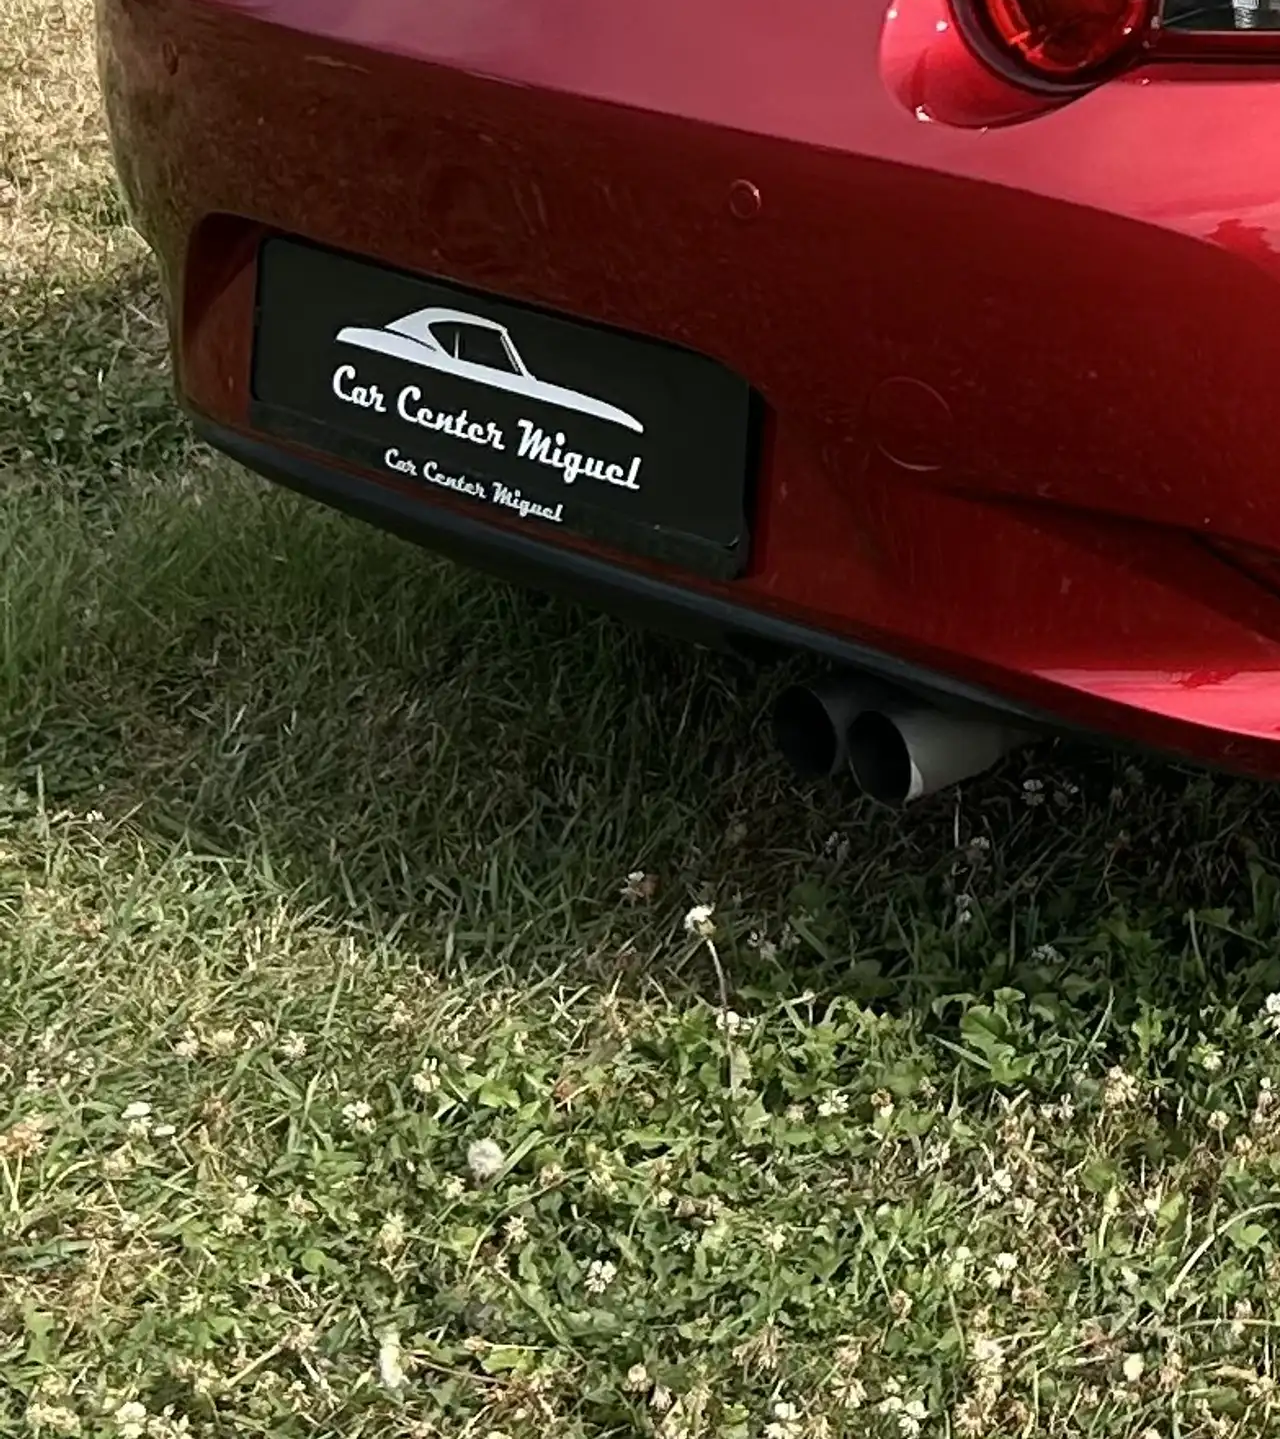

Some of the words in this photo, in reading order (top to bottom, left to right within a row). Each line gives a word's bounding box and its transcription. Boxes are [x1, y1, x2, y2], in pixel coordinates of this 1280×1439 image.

[332, 364, 387, 413] Car
[396, 385, 506, 450] Center
[516, 418, 643, 490] Miguel
[384, 448, 418, 477] Car
[423, 460, 487, 500] Center
[491, 481, 565, 523] Miguel
